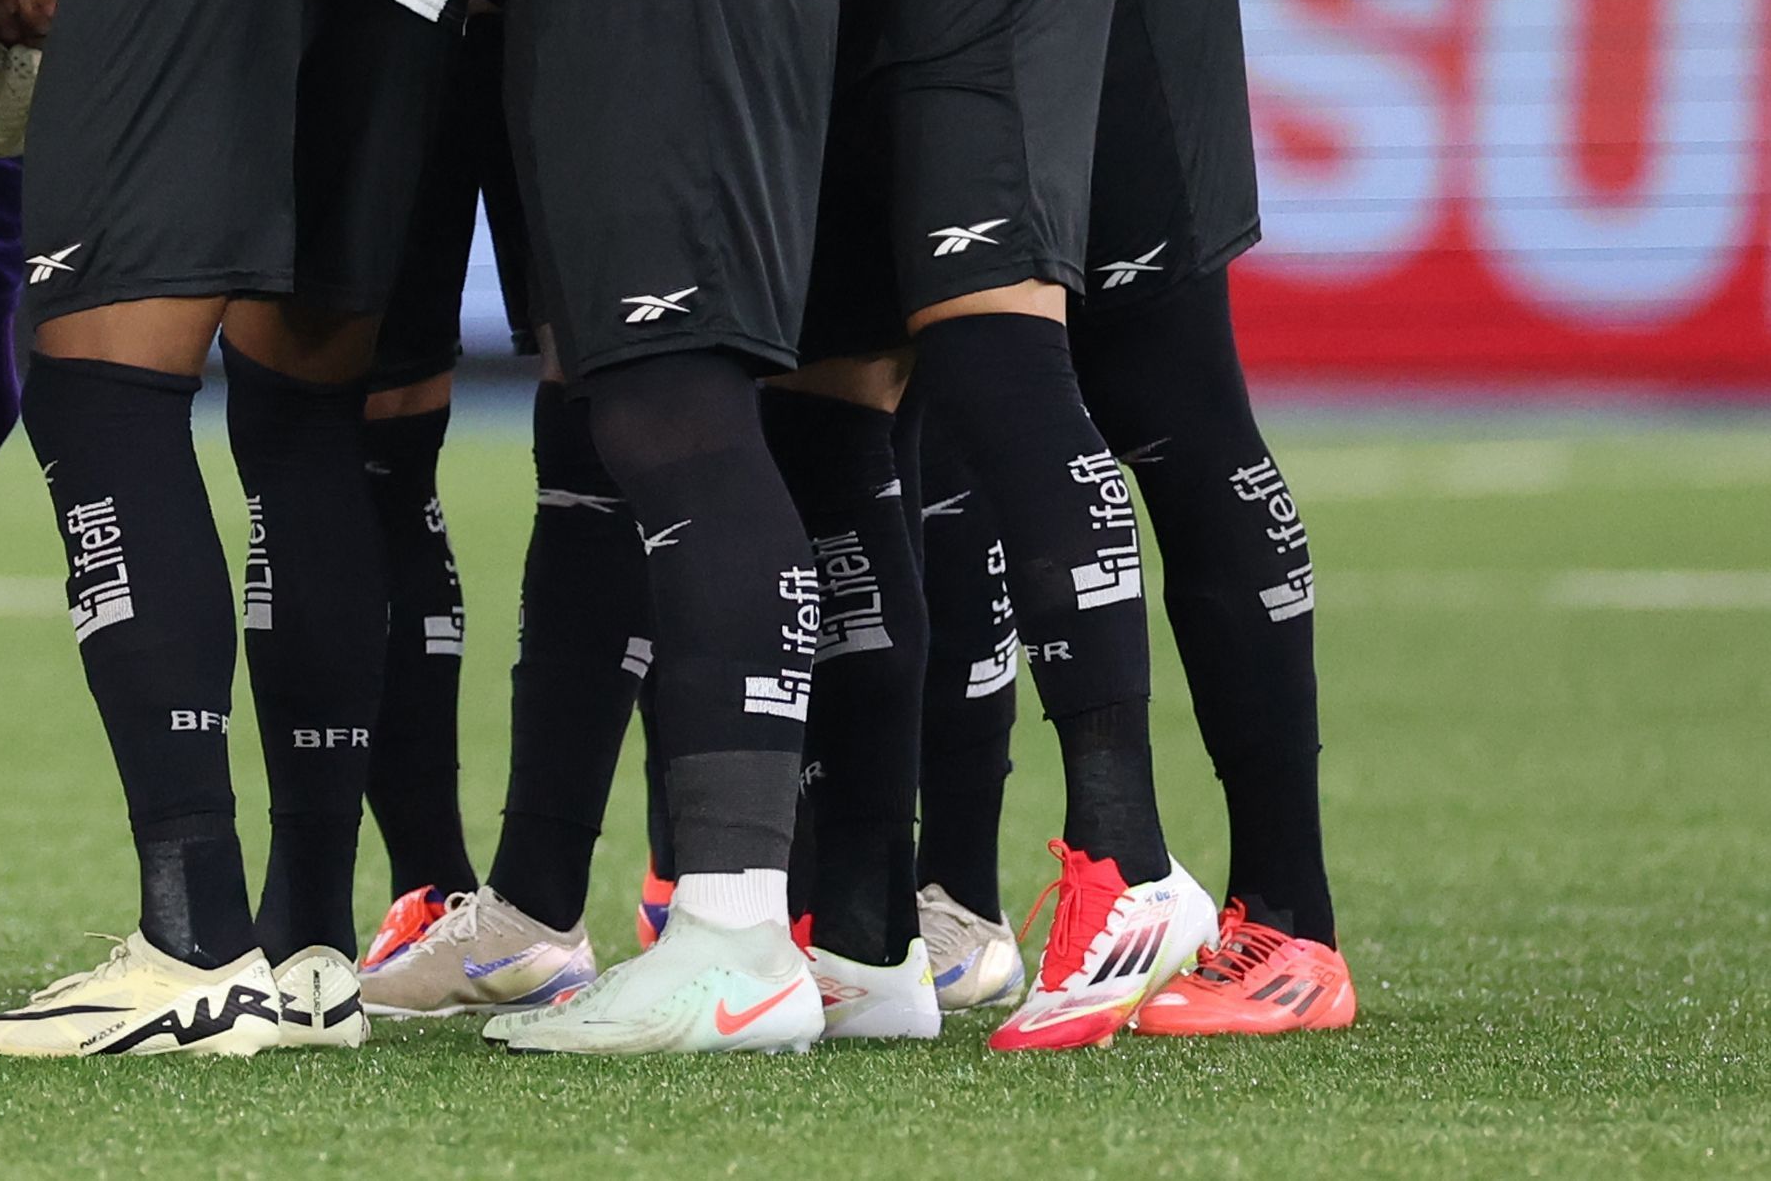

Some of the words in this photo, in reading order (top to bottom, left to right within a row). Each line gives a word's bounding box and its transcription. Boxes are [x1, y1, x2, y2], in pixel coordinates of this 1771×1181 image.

[1067, 448, 1140, 559] Lifefit
[66, 496, 130, 601] Lifefit
[1024, 639, 1074, 664] FR
[293, 727, 370, 749] BFR
